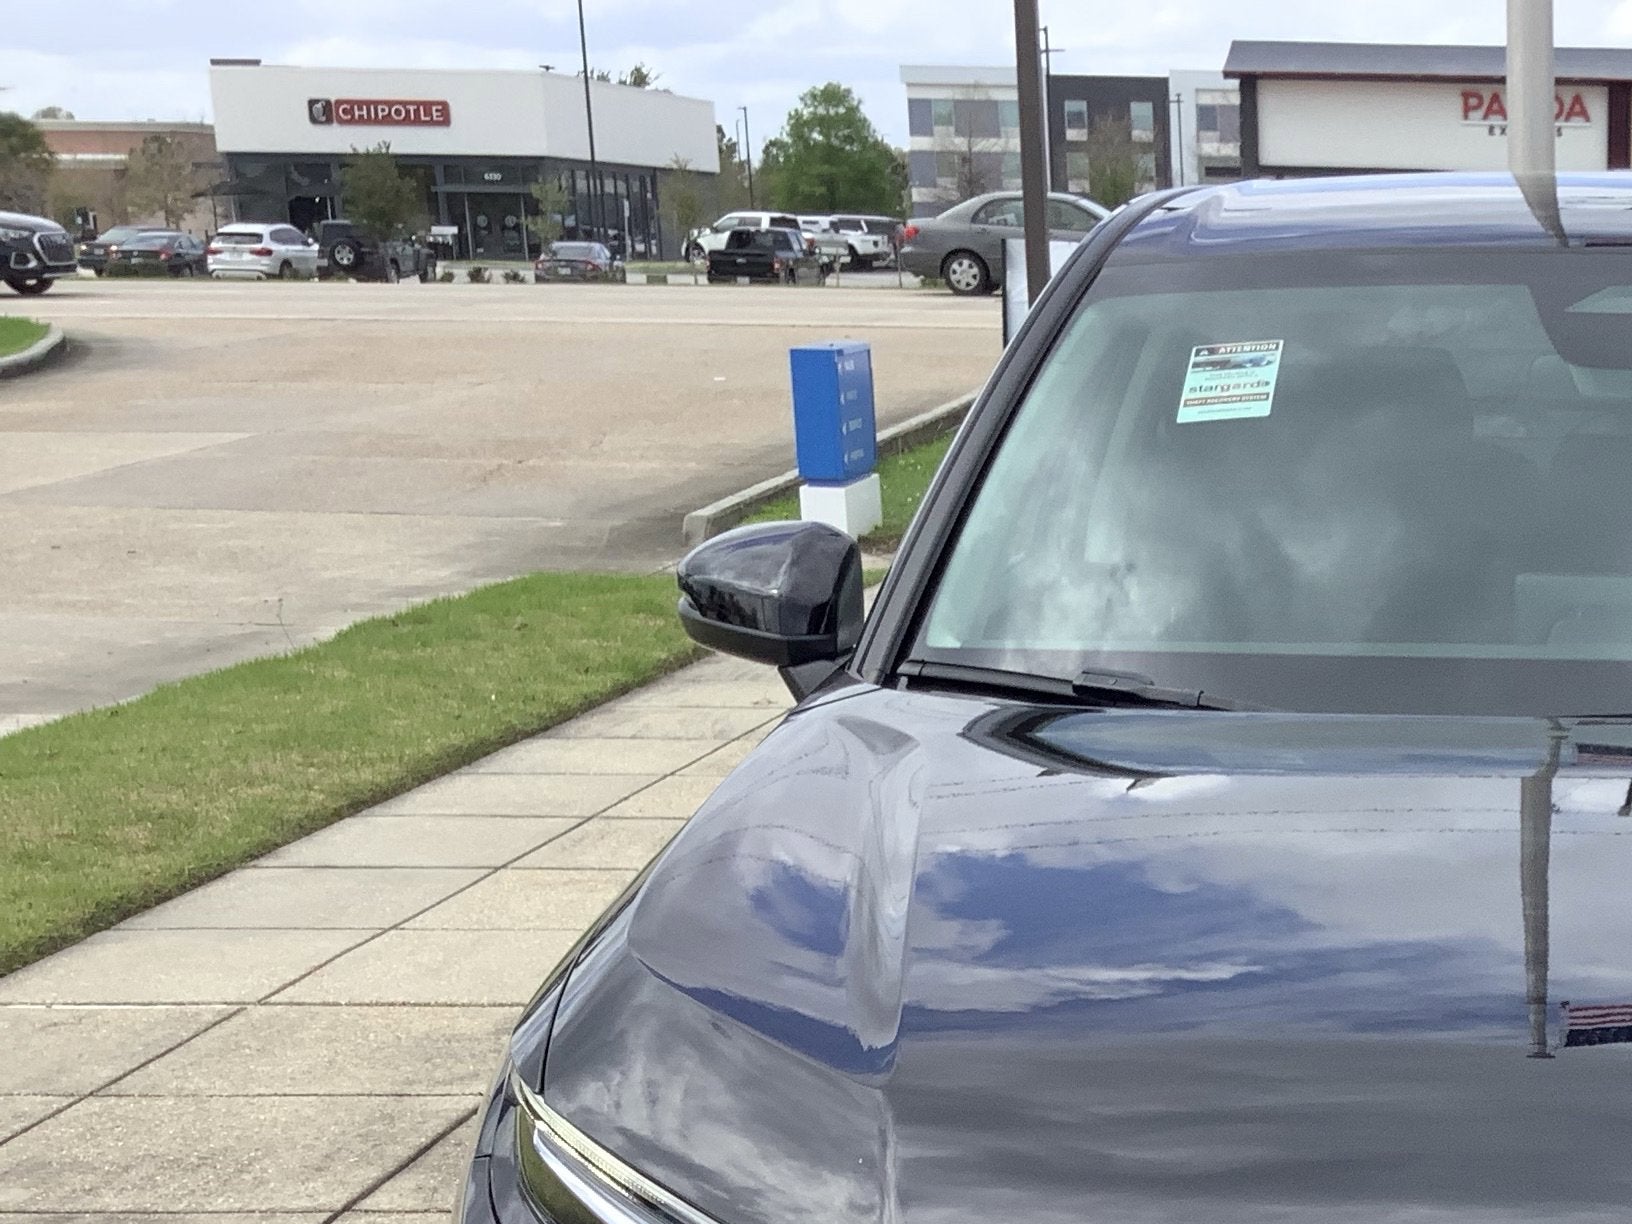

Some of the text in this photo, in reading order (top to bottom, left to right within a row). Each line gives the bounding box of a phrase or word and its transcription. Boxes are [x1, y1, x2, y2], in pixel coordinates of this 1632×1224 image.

[339, 104, 444, 120] CHIPOTLE
[1461, 91, 1590, 122] PAA
[1219, 343, 1277, 354] ATTENTION
